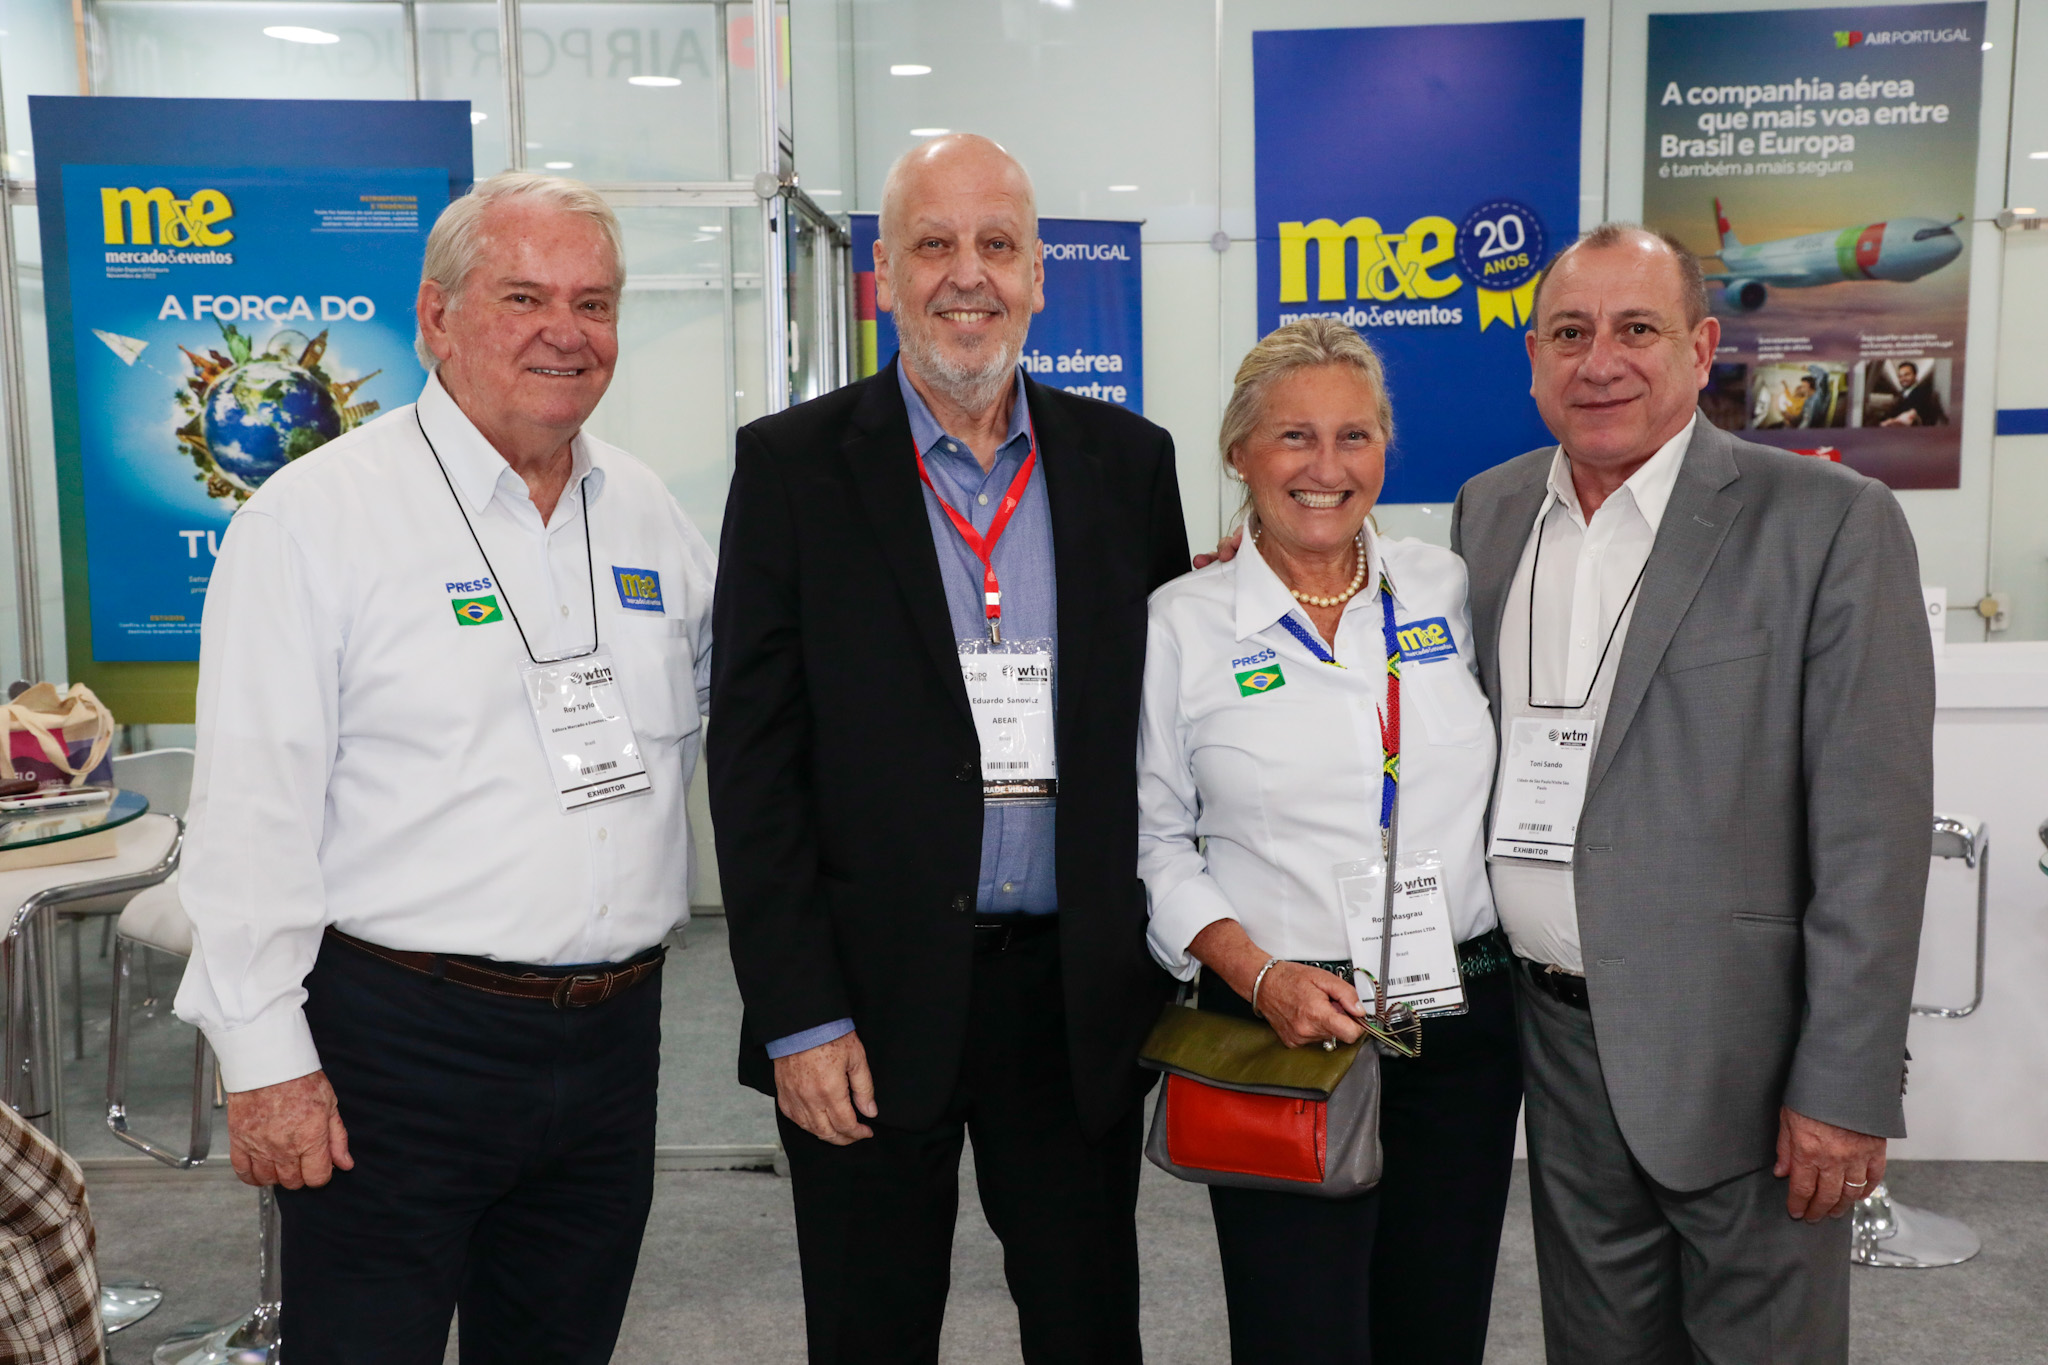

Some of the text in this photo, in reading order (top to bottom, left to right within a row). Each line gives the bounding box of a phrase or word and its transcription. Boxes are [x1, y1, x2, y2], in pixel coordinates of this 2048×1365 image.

[1661, 75, 1915, 109] A companhia aérea
[1698, 102, 1949, 137] que mais voa entre
[1660, 131, 1855, 158] Brasil e Europa
[1672, 160, 1741, 178] também
[1743, 163, 1754, 176] a
[1756, 160, 1795, 175] mais
[1797, 159, 1854, 177] segura
[101, 187, 234, 248] m&e
[1474, 214, 1525, 258] 20
[105, 249, 233, 264] mercado&eventos
[1043, 244, 1131, 260] PORTUGAL
[1278, 215, 1463, 303] m&e
[1484, 253, 1529, 276] ANOS
[158, 295, 376, 326] A FORÇA DO
[1056, 348, 1123, 373] aérea
[179, 530, 219, 558] TU
[445, 577, 492, 593] PRESS
[1232, 648, 1276, 669] PRESS
[583, 667, 612, 680] wtm
[563, 701, 595, 713] Roy Taylo
[1562, 730, 1588, 741] wtm
[1544, 760, 1563, 768] Sando
[587, 784, 625, 798] EXHIBITOR
[1008, 785, 1039, 793] VISITOR
[1513, 846, 1549, 855] EXHIBITOR
[1404, 876, 1436, 889] wtm
[1391, 910, 1423, 920] Masgrau
